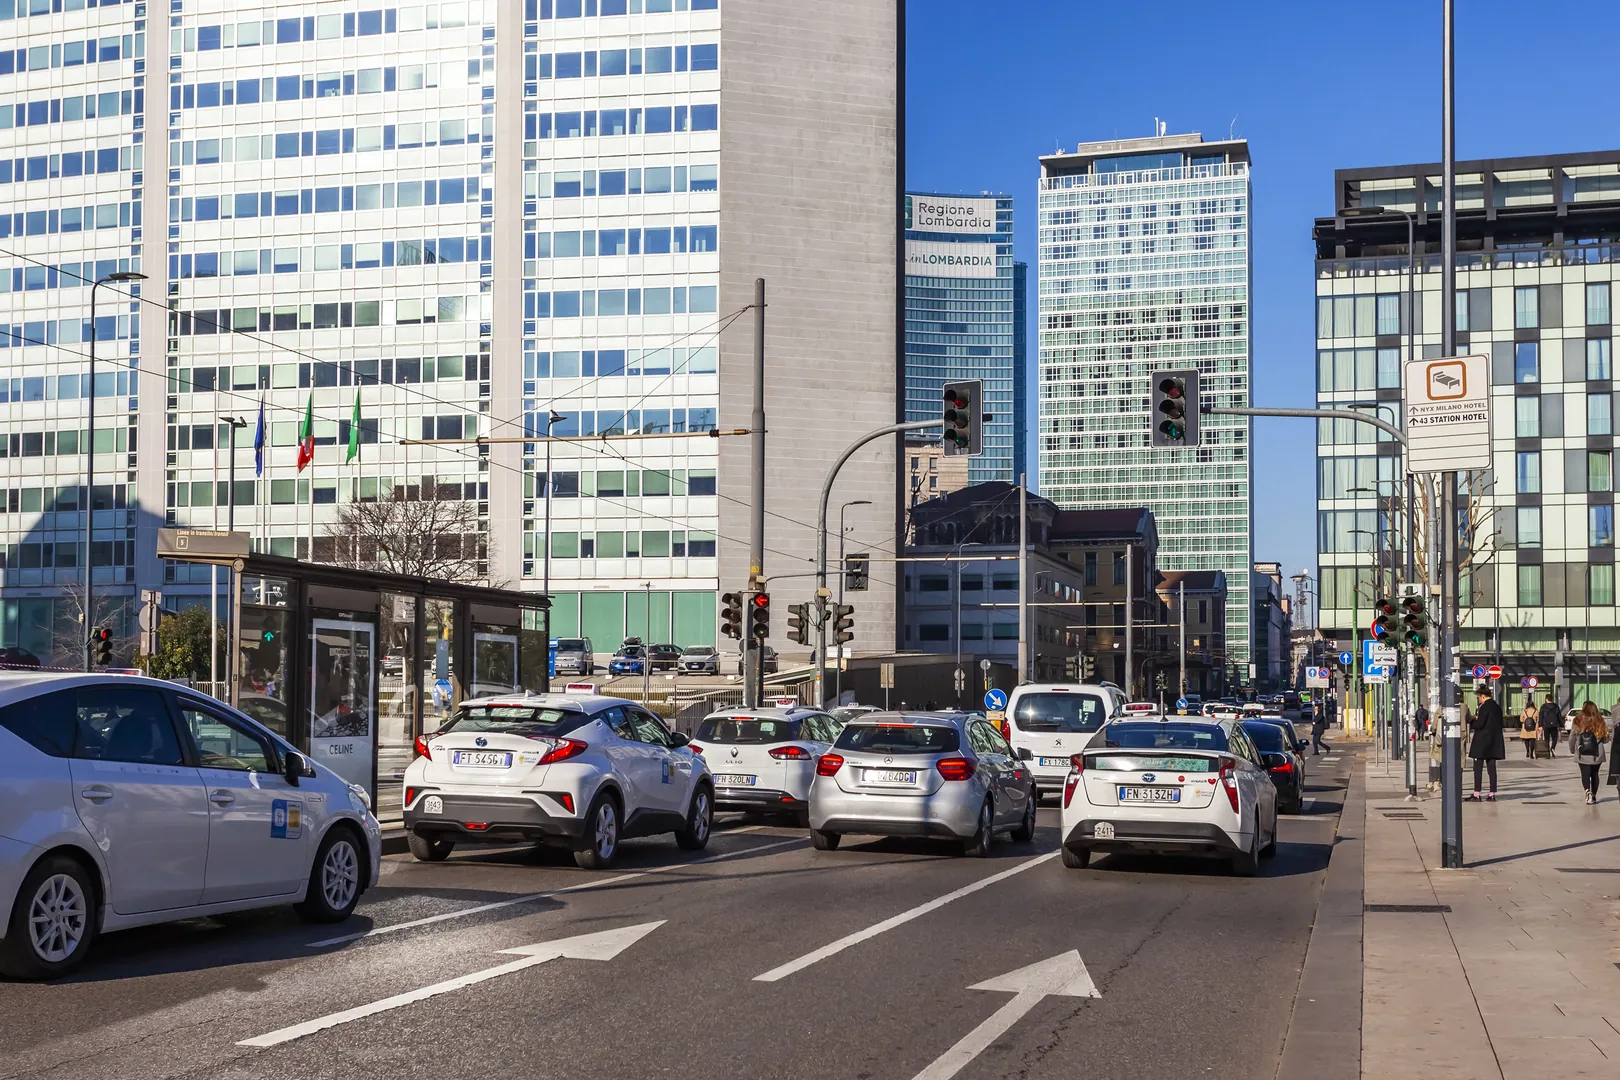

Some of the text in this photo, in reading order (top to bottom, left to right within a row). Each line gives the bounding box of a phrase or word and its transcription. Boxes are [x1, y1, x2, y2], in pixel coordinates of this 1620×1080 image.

[919, 202, 974, 216] Regione
[919, 214, 991, 228] Lombardia
[1430, 414, 1461, 424] STATION
[1463, 413, 1487, 421] HOTEL
[329, 744, 354, 755] CELINE
[460, 753, 472, 764] FT
[1126, 788, 1173, 800] FN 313ZH
